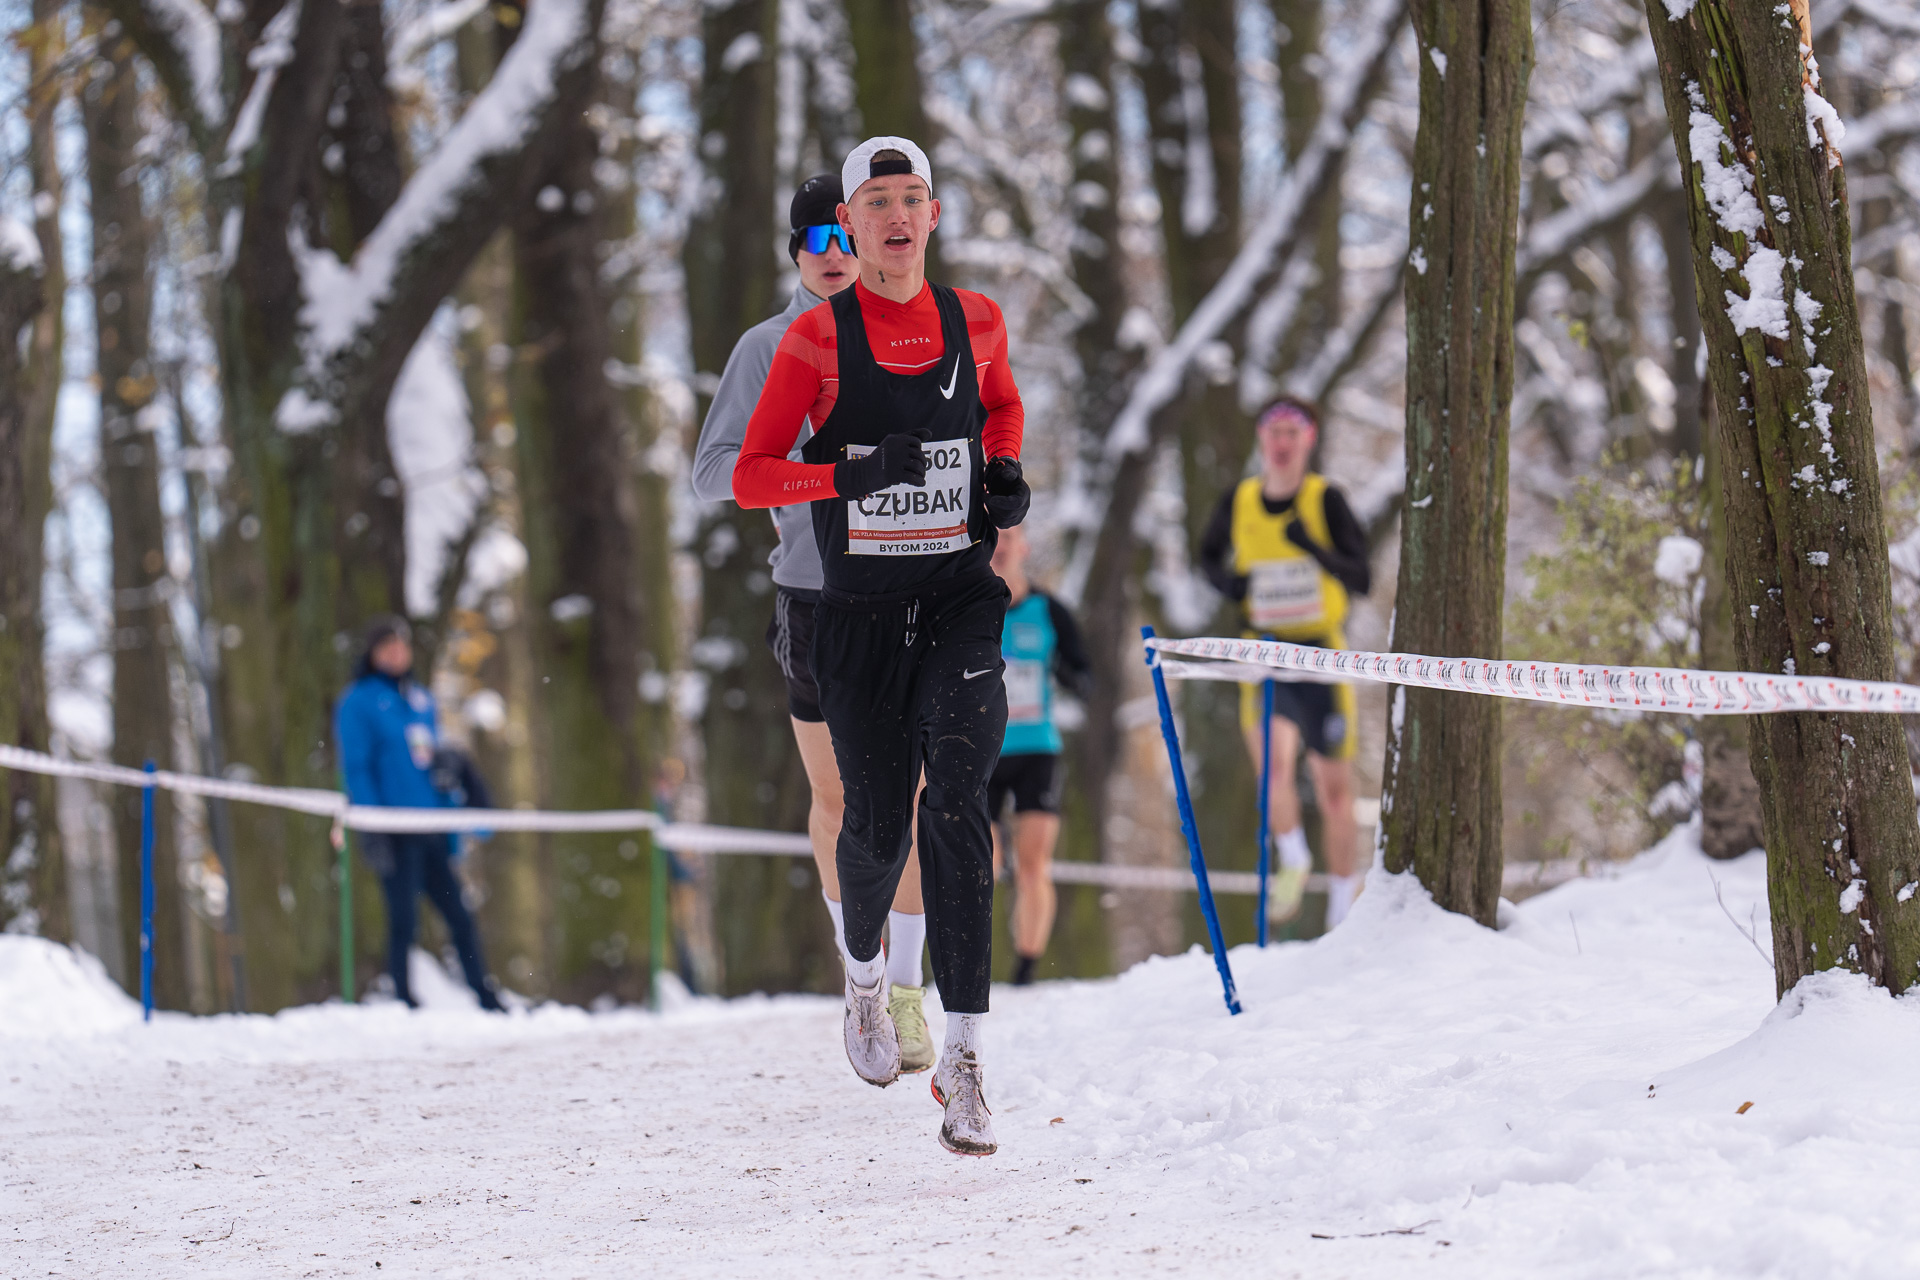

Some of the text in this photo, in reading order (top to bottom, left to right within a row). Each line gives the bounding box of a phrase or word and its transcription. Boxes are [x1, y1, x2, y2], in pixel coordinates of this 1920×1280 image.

[891, 337, 931, 347] KIPSTA
[783, 479, 822, 491] KIPSTA
[857, 487, 964, 517] CZUBAK
[879, 541, 950, 553] BYTOM 2024
